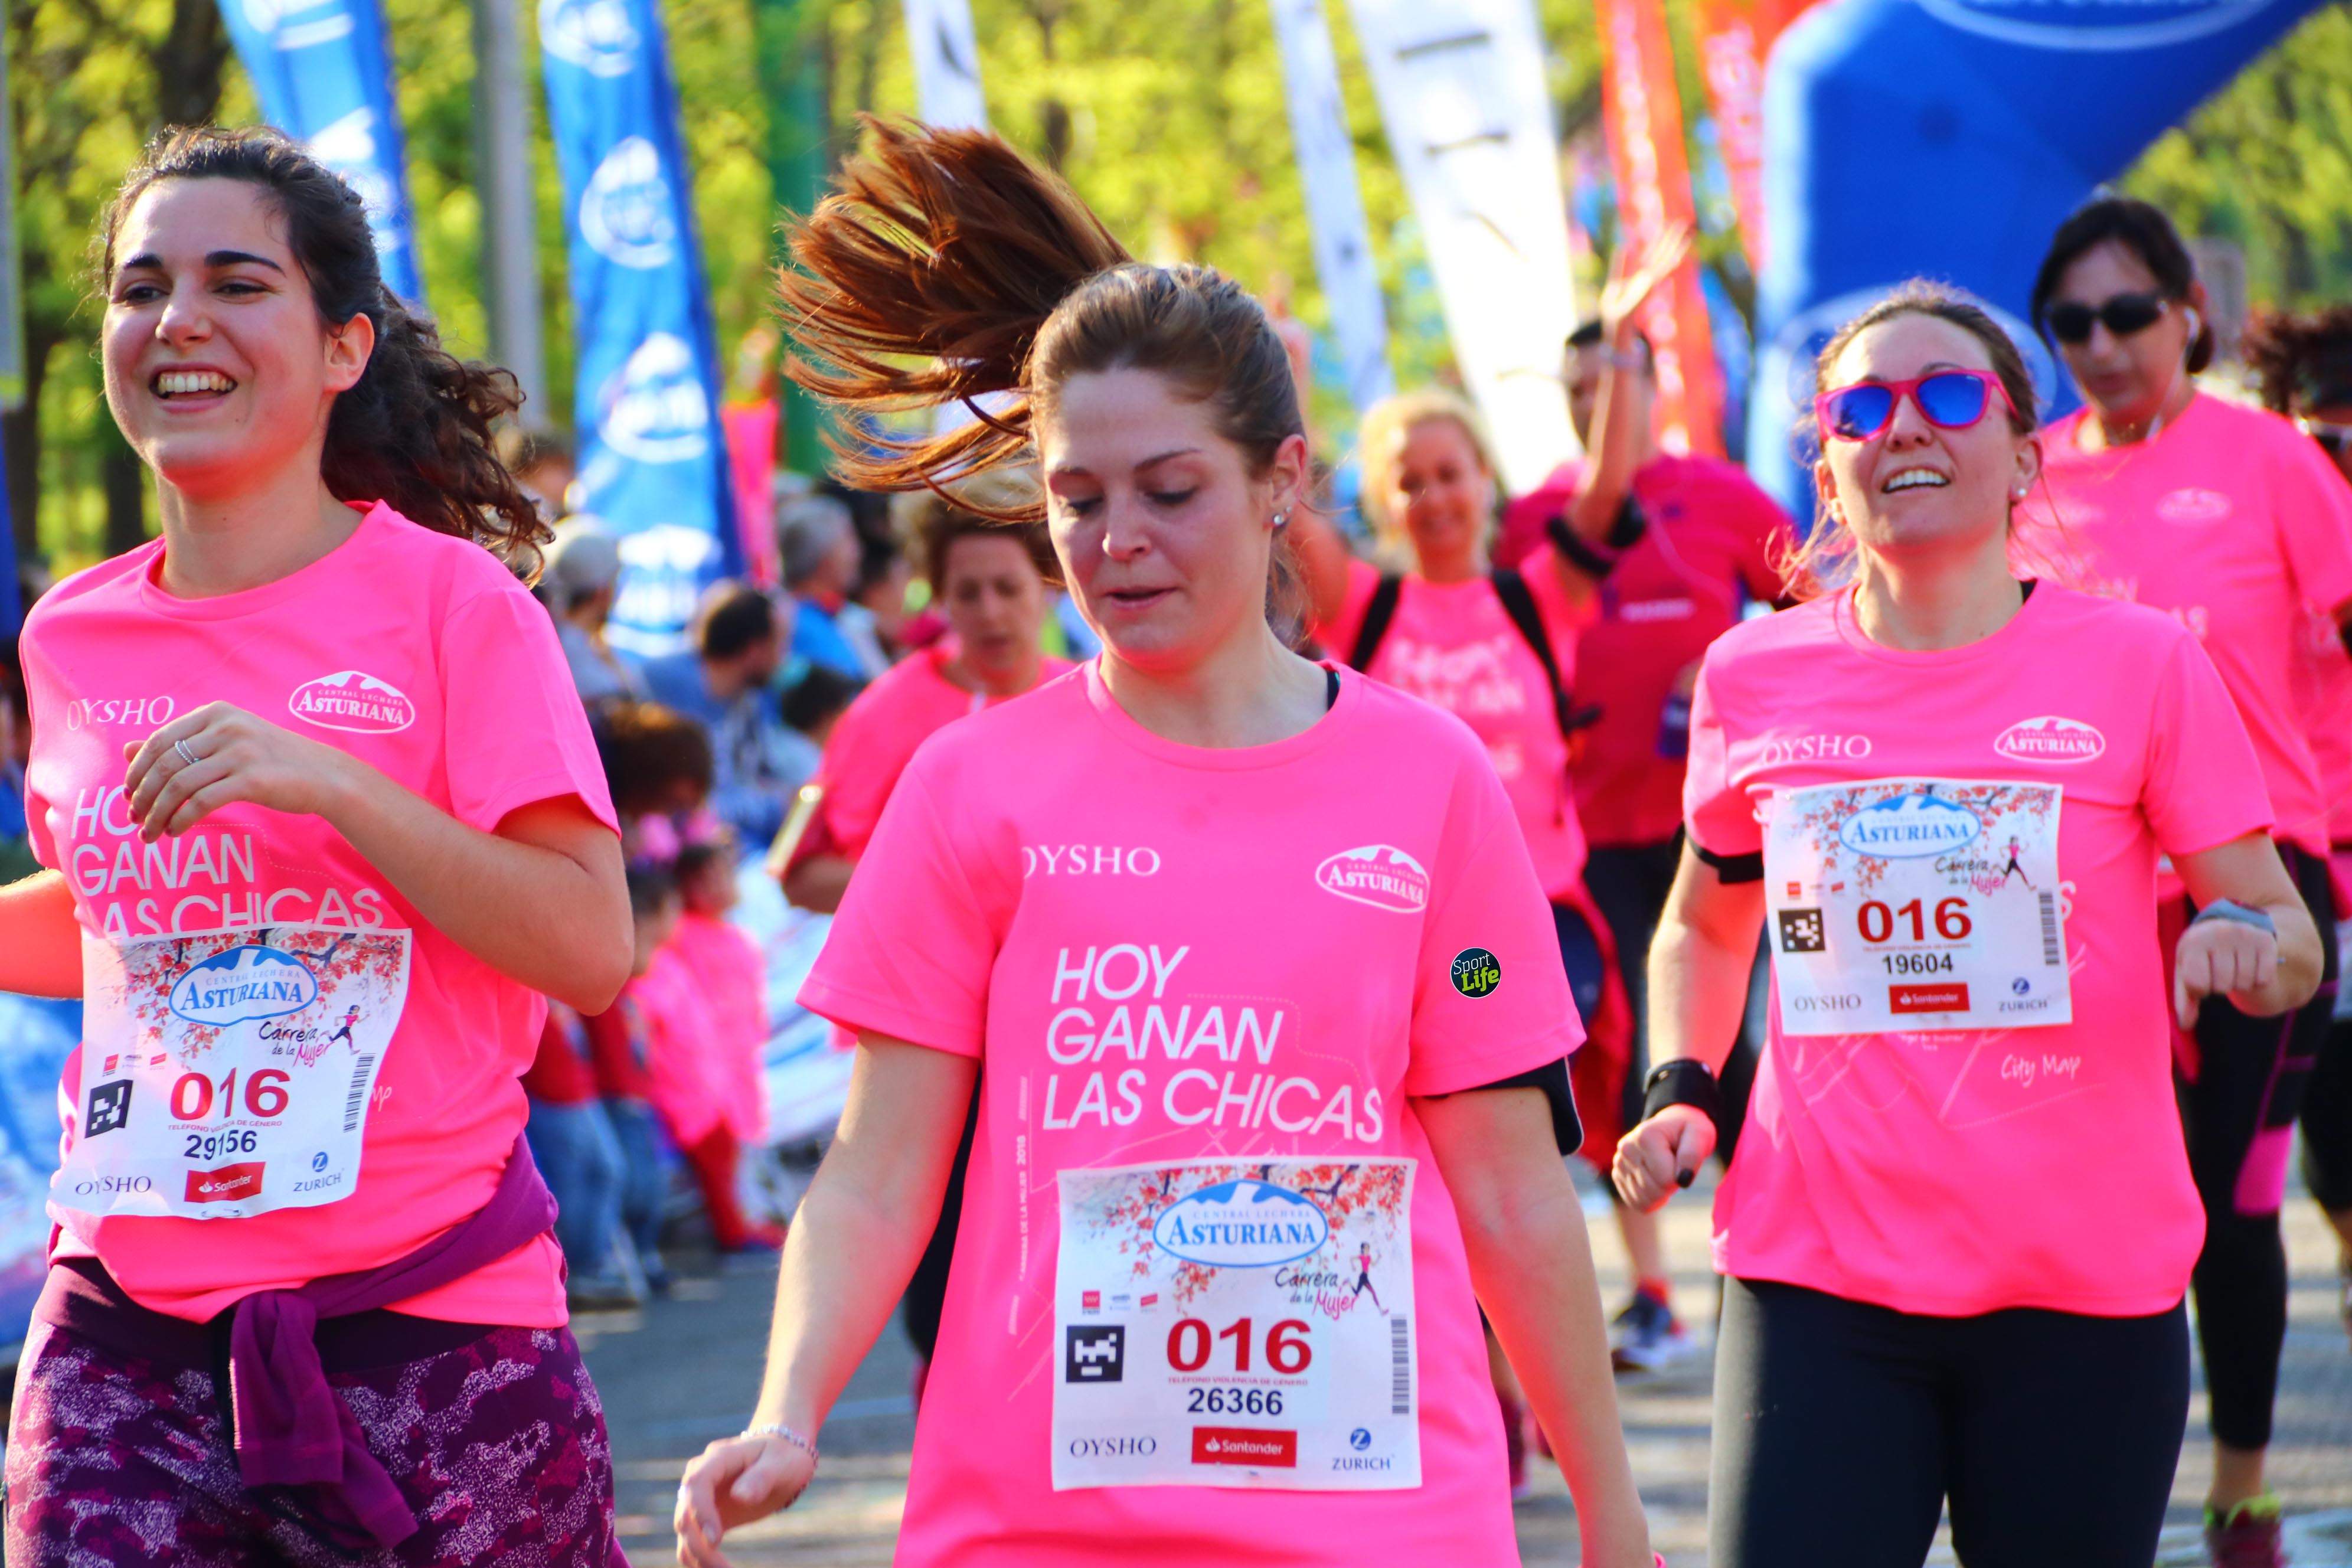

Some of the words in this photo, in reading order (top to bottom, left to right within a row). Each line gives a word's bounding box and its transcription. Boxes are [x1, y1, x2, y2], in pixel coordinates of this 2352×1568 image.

[66, 695, 174, 731] OYSHO
[296, 690, 405, 725] ASTURIANA
[1761, 734, 1872, 765] OYSHO
[2002, 734, 2098, 754] ASTURIANA
[71, 786, 139, 838] HO
[1851, 821, 1969, 844] ASTURIANA
[73, 834, 254, 897] GANAN
[1327, 864, 1424, 904] ASTURIANA
[102, 897, 164, 939] AS
[171, 888, 384, 933] CHICAS
[1857, 896, 1972, 943] 016
[1051, 943, 1189, 1003] HOY
[1882, 952, 1954, 974] 19604
[179, 981, 303, 1011] ASTURIANA
[1794, 994, 1862, 1012] OYSHO
[1912, 992, 1959, 1004] Santander
[1998, 999, 2048, 1013] ZURICH
[259, 1021, 319, 1043] Carrera
[1046, 1005, 1283, 1064] GANAN
[272, 1043, 283, 1056] de
[285, 1043, 295, 1056] la
[293, 1042, 336, 1068] Mujer
[2001, 1054, 2036, 1089] City
[2042, 1053, 2082, 1082] Map
[169, 1067, 290, 1121] 016
[1043, 1069, 1146, 1130] LAS
[1162, 1069, 1383, 1144] CHICAS
[184, 1129, 258, 1161] 29156
[1016, 1135, 1027, 1166] 2018
[75, 1175, 152, 1195] OYSHO
[214, 1174, 253, 1193] Santander
[293, 1172, 342, 1192] ZURICH
[1167, 1214, 1317, 1246] ASTURIANA
[1275, 1266, 1338, 1288] Carrera
[1289, 1291, 1302, 1304] de
[1312, 1287, 1358, 1321] Mujer
[1167, 1317, 1312, 1374] 016
[1187, 1387, 1283, 1416] 26366
[1070, 1436, 1157, 1458] OYSHO
[1221, 1439, 1283, 1456] Santander
[1332, 1457, 1391, 1471] ZURICH
